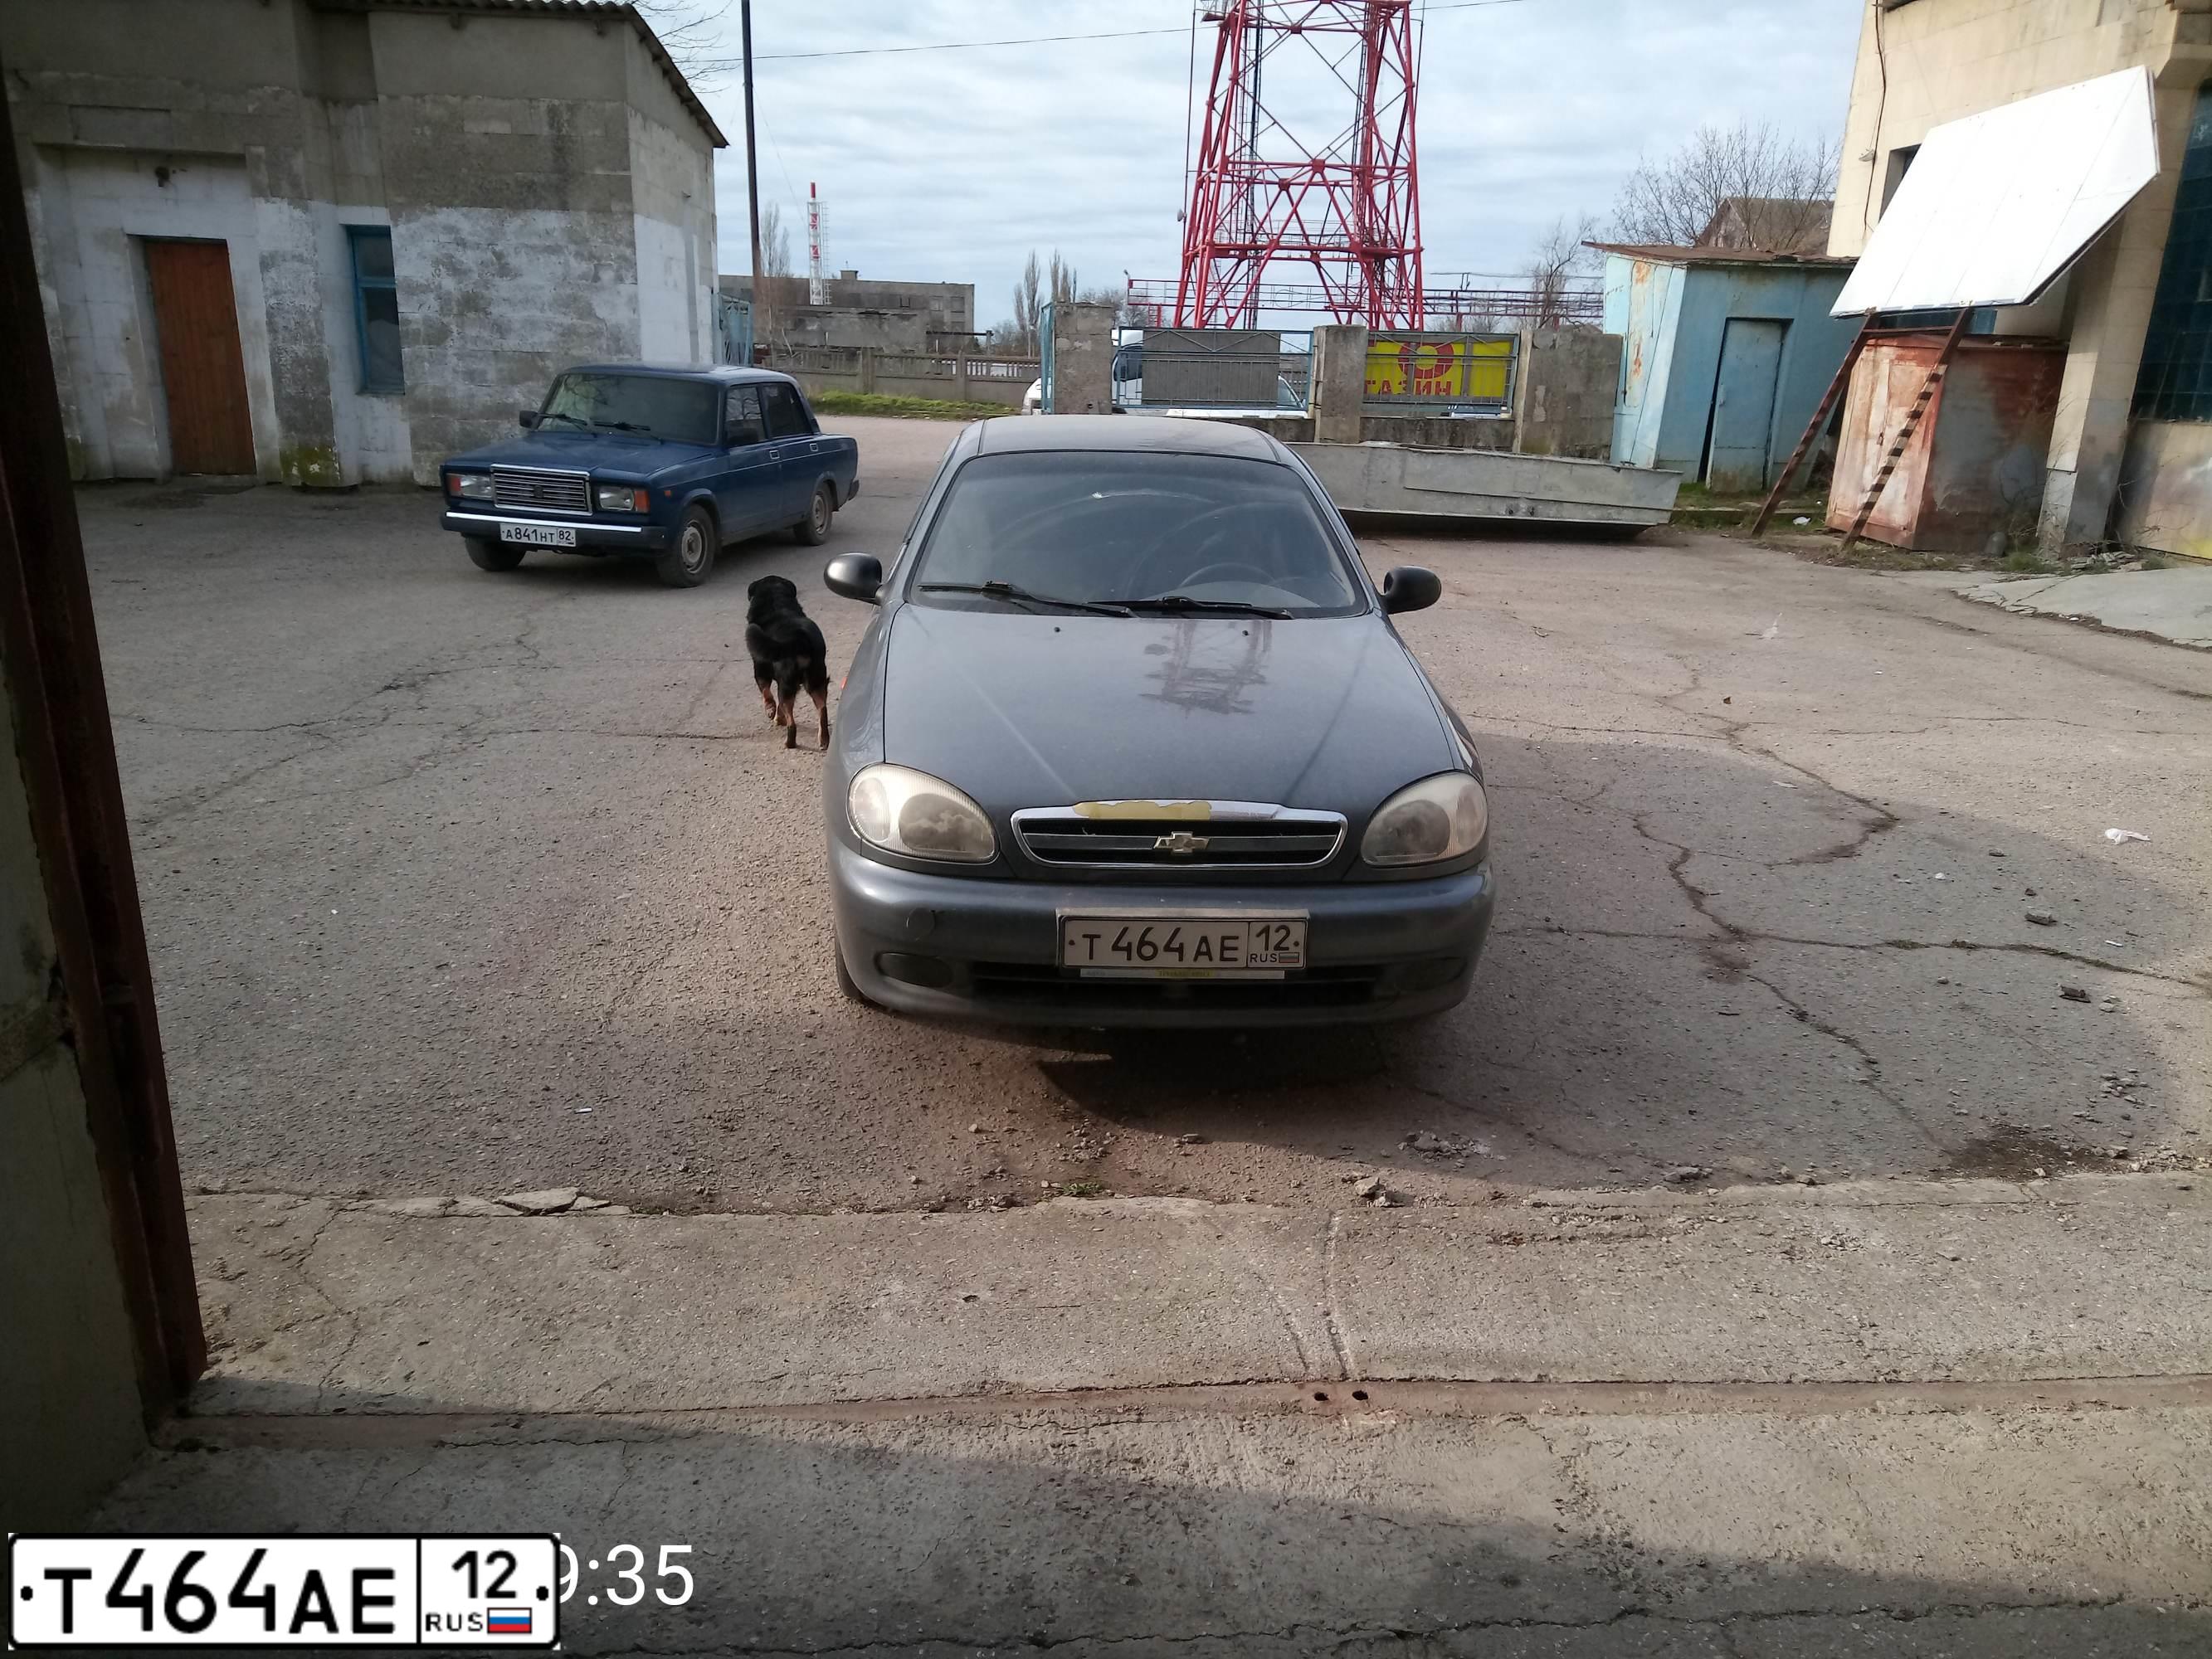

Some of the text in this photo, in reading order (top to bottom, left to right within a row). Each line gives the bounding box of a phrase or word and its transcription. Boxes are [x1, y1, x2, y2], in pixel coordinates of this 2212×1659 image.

[558, 530, 571, 540] 82
[1081, 925, 1290, 961] Т464АЕ 12
[1250, 953, 1277, 963] RUS
